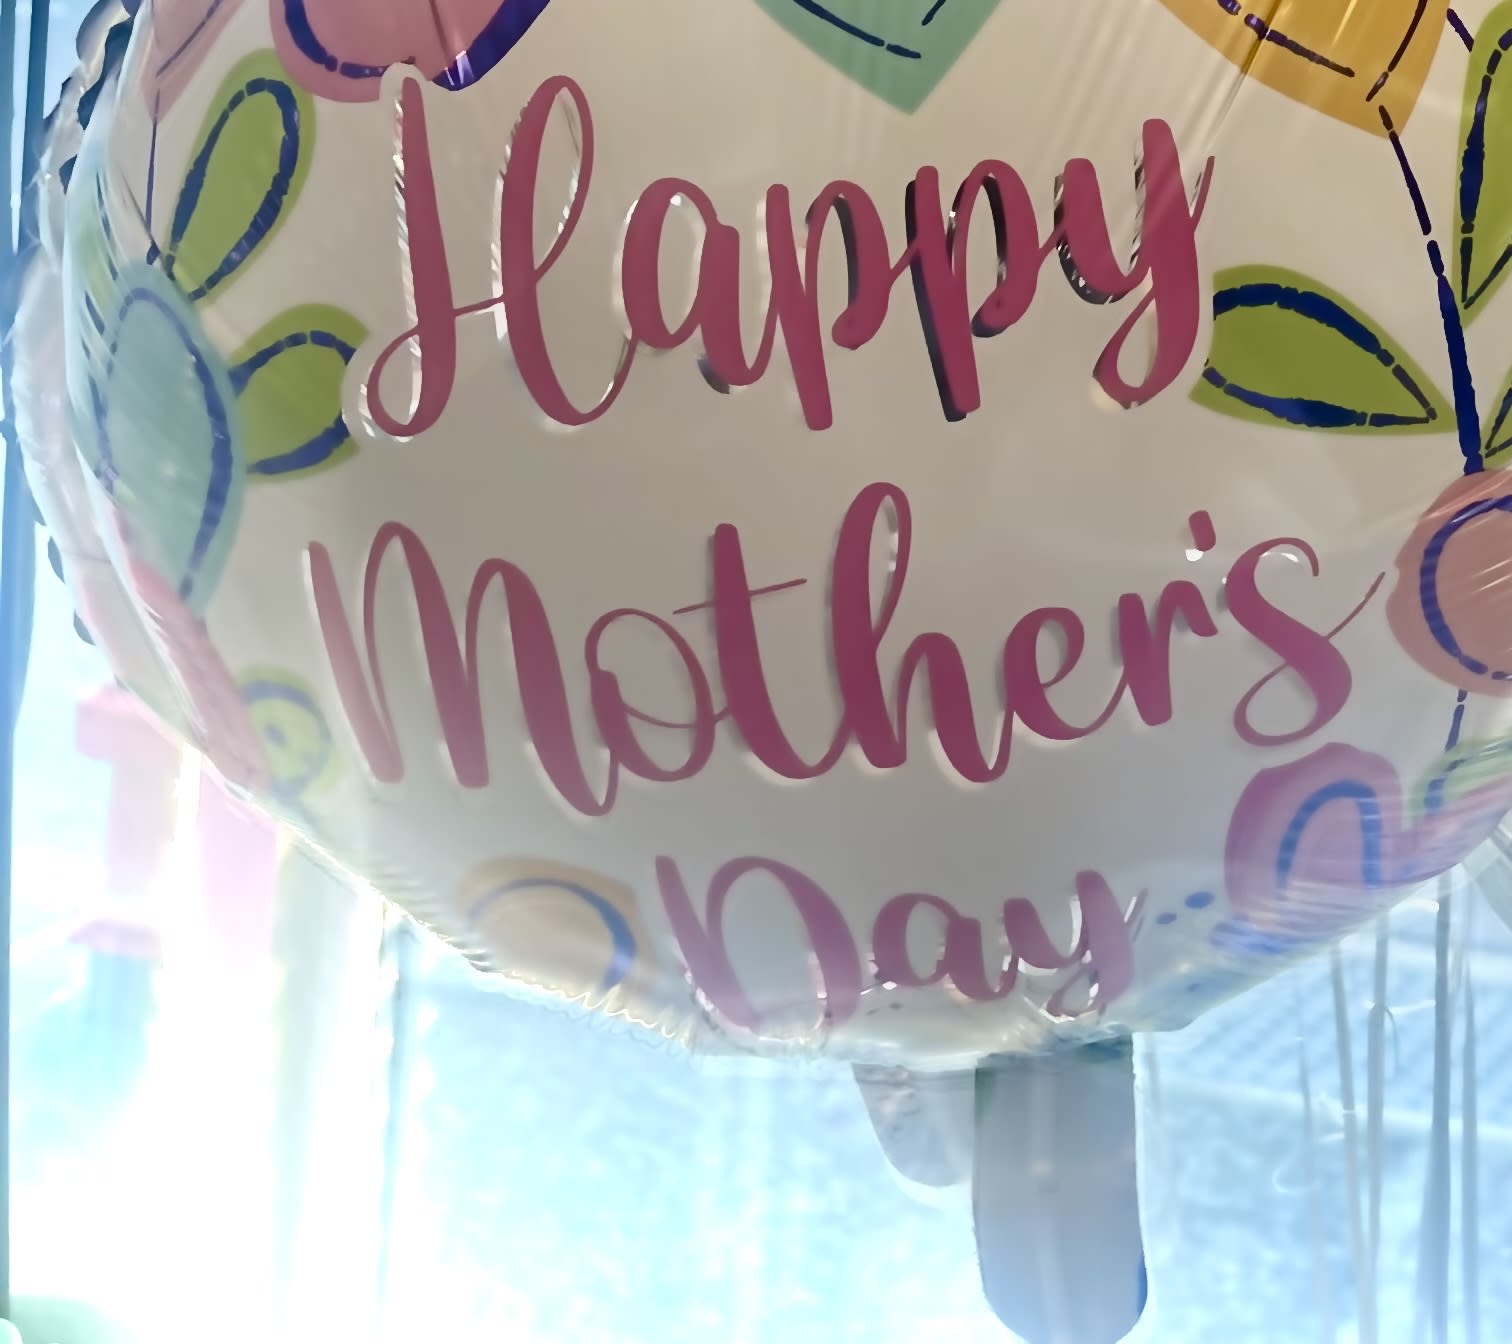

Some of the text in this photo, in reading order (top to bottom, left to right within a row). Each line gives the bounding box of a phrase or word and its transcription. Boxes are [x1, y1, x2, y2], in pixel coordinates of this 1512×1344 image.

[360, 72, 1216, 438] Happy
[307, 482, 1386, 818] Mother's
[655, 854, 1148, 1037] Day
